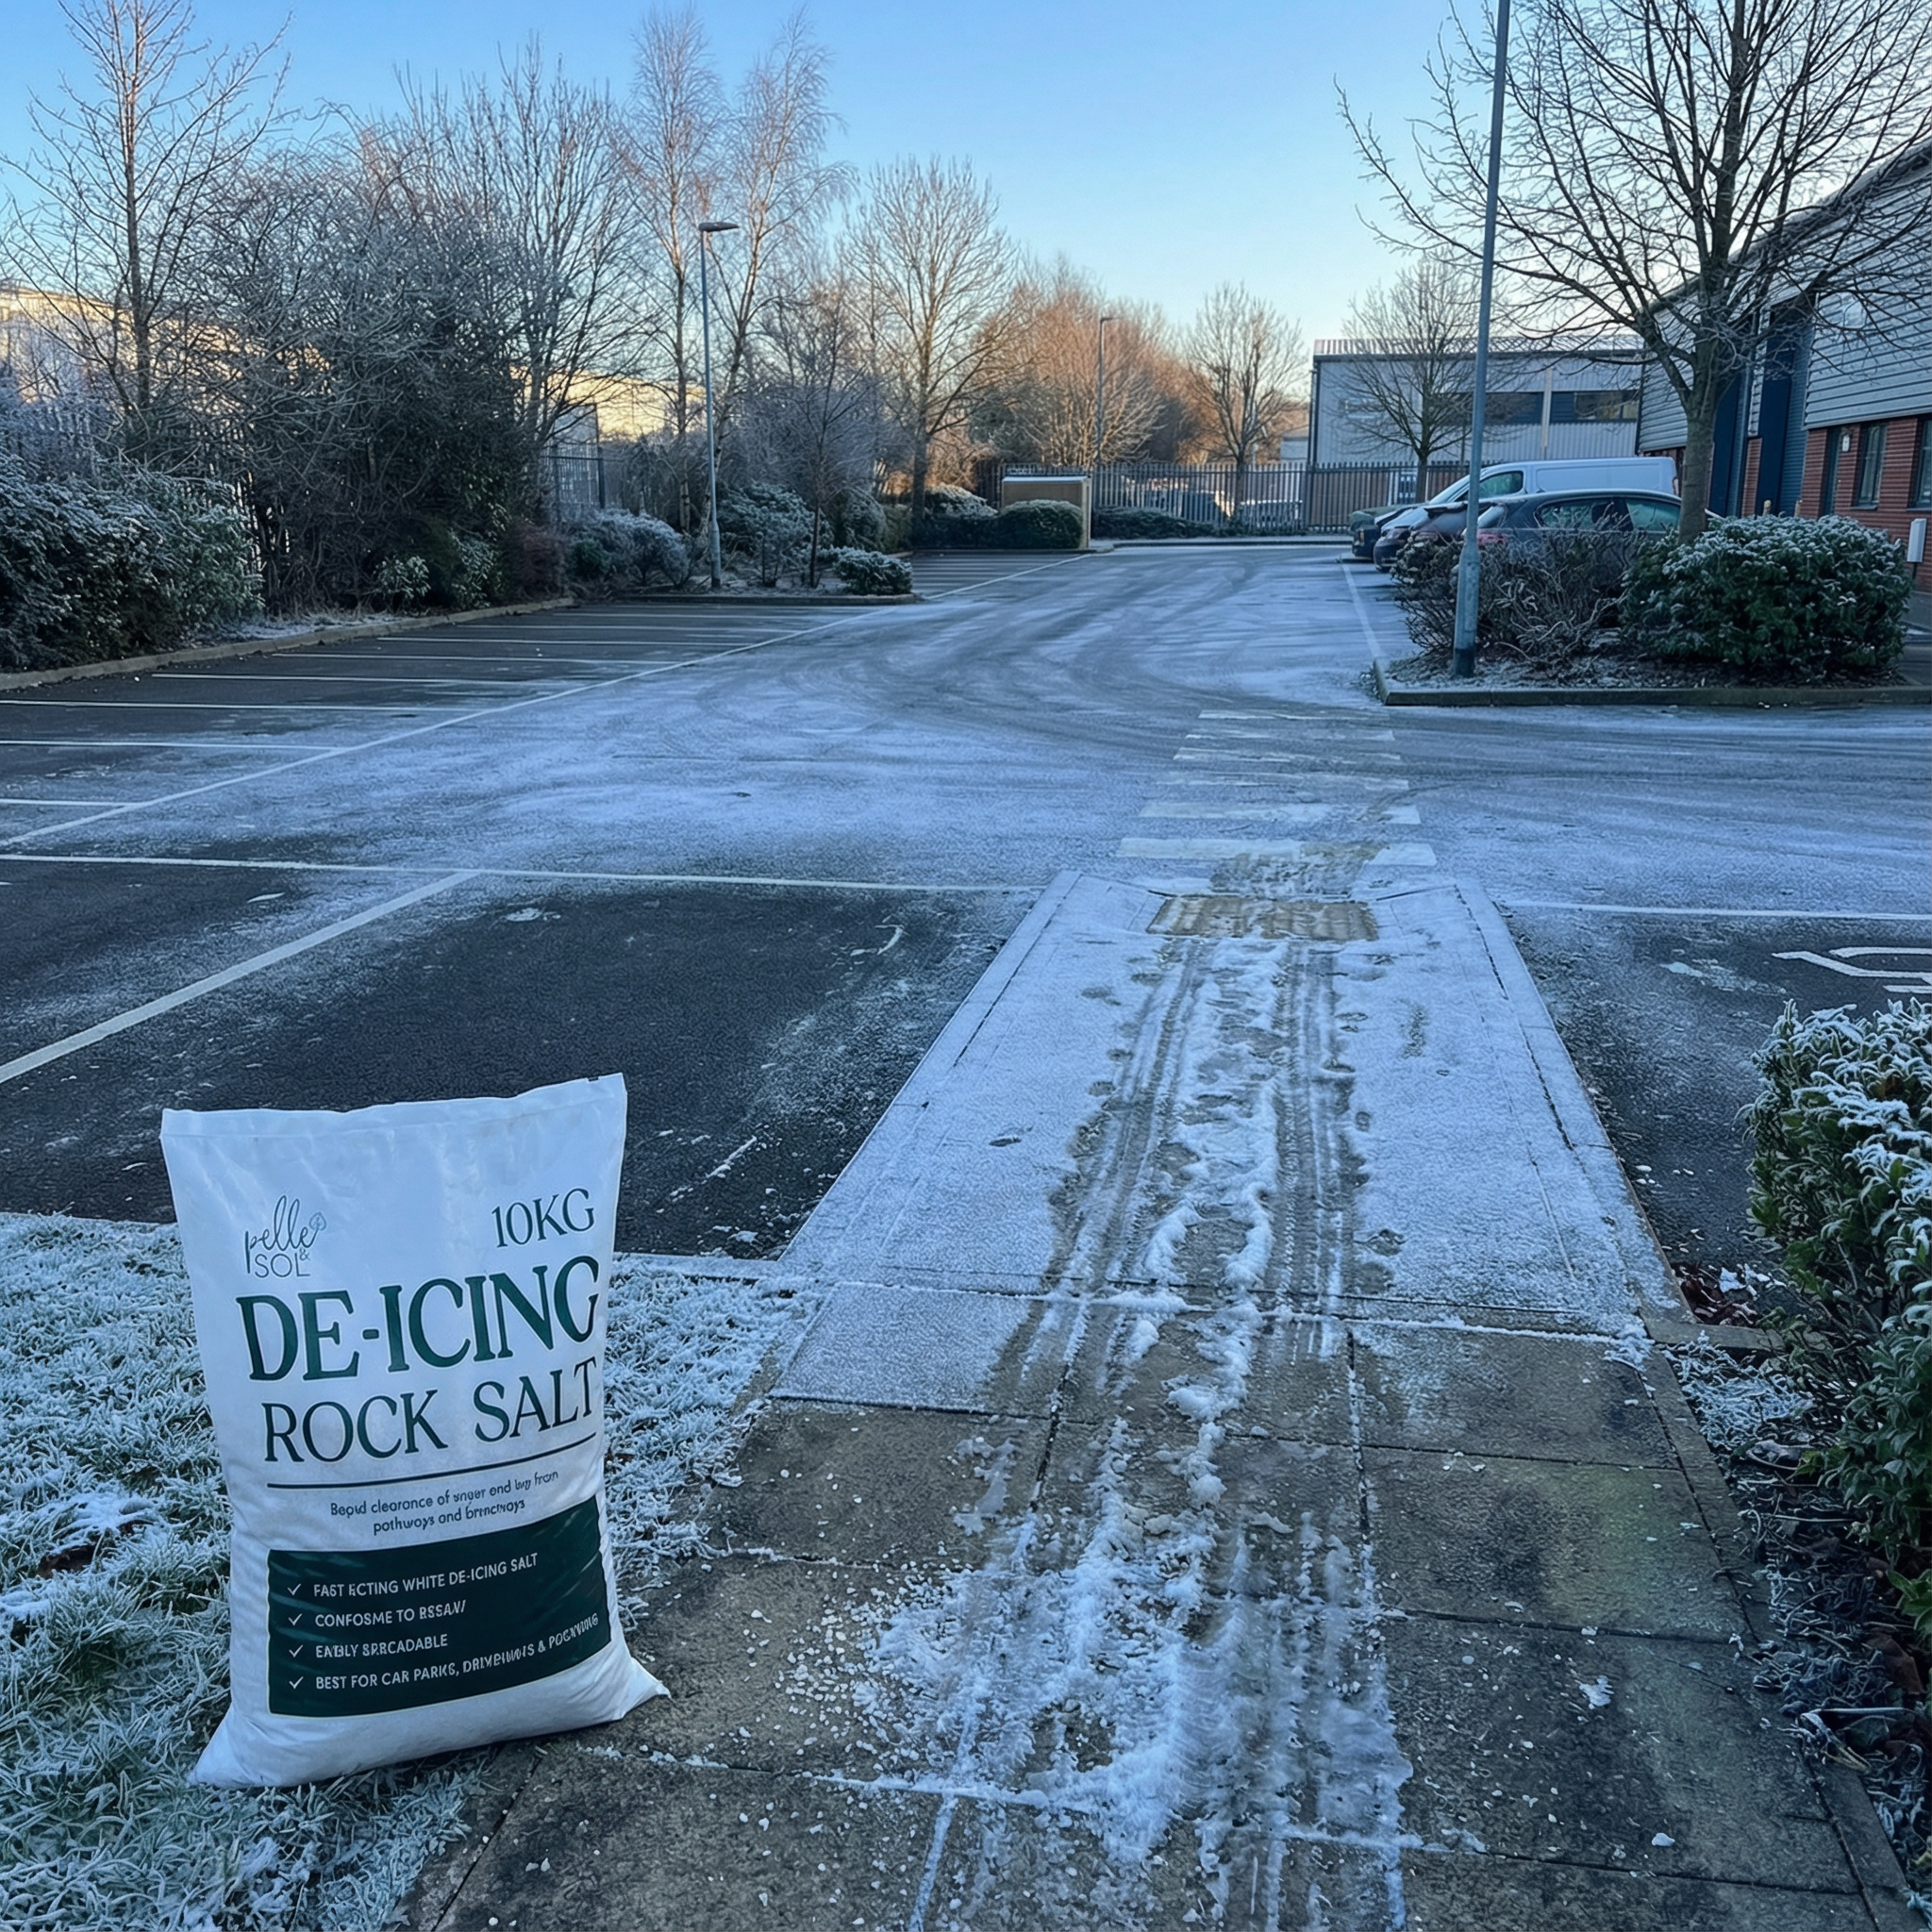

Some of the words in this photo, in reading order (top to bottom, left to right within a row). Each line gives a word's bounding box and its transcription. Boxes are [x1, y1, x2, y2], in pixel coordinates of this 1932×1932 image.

[245, 1195, 321, 1274] pelle
[491, 1187, 596, 1248] 10KG
[254, 1253, 311, 1279] SOL
[235, 1254, 600, 1381] DE-ICING
[261, 1389, 449, 1463] ROCK
[474, 1356, 597, 1443] SALT
[437, 1489, 450, 1506] of
[313, 1583, 345, 1597] FAST
[402, 1573, 446, 1592] WHITE
[448, 1560, 508, 1586] DE-ICING
[510, 1552, 538, 1573] SALT
[395, 1607, 415, 1623] TO
[315, 1675, 347, 1690] BEST
[351, 1674, 377, 1689] FOR
[381, 1670, 409, 1686] CAR
